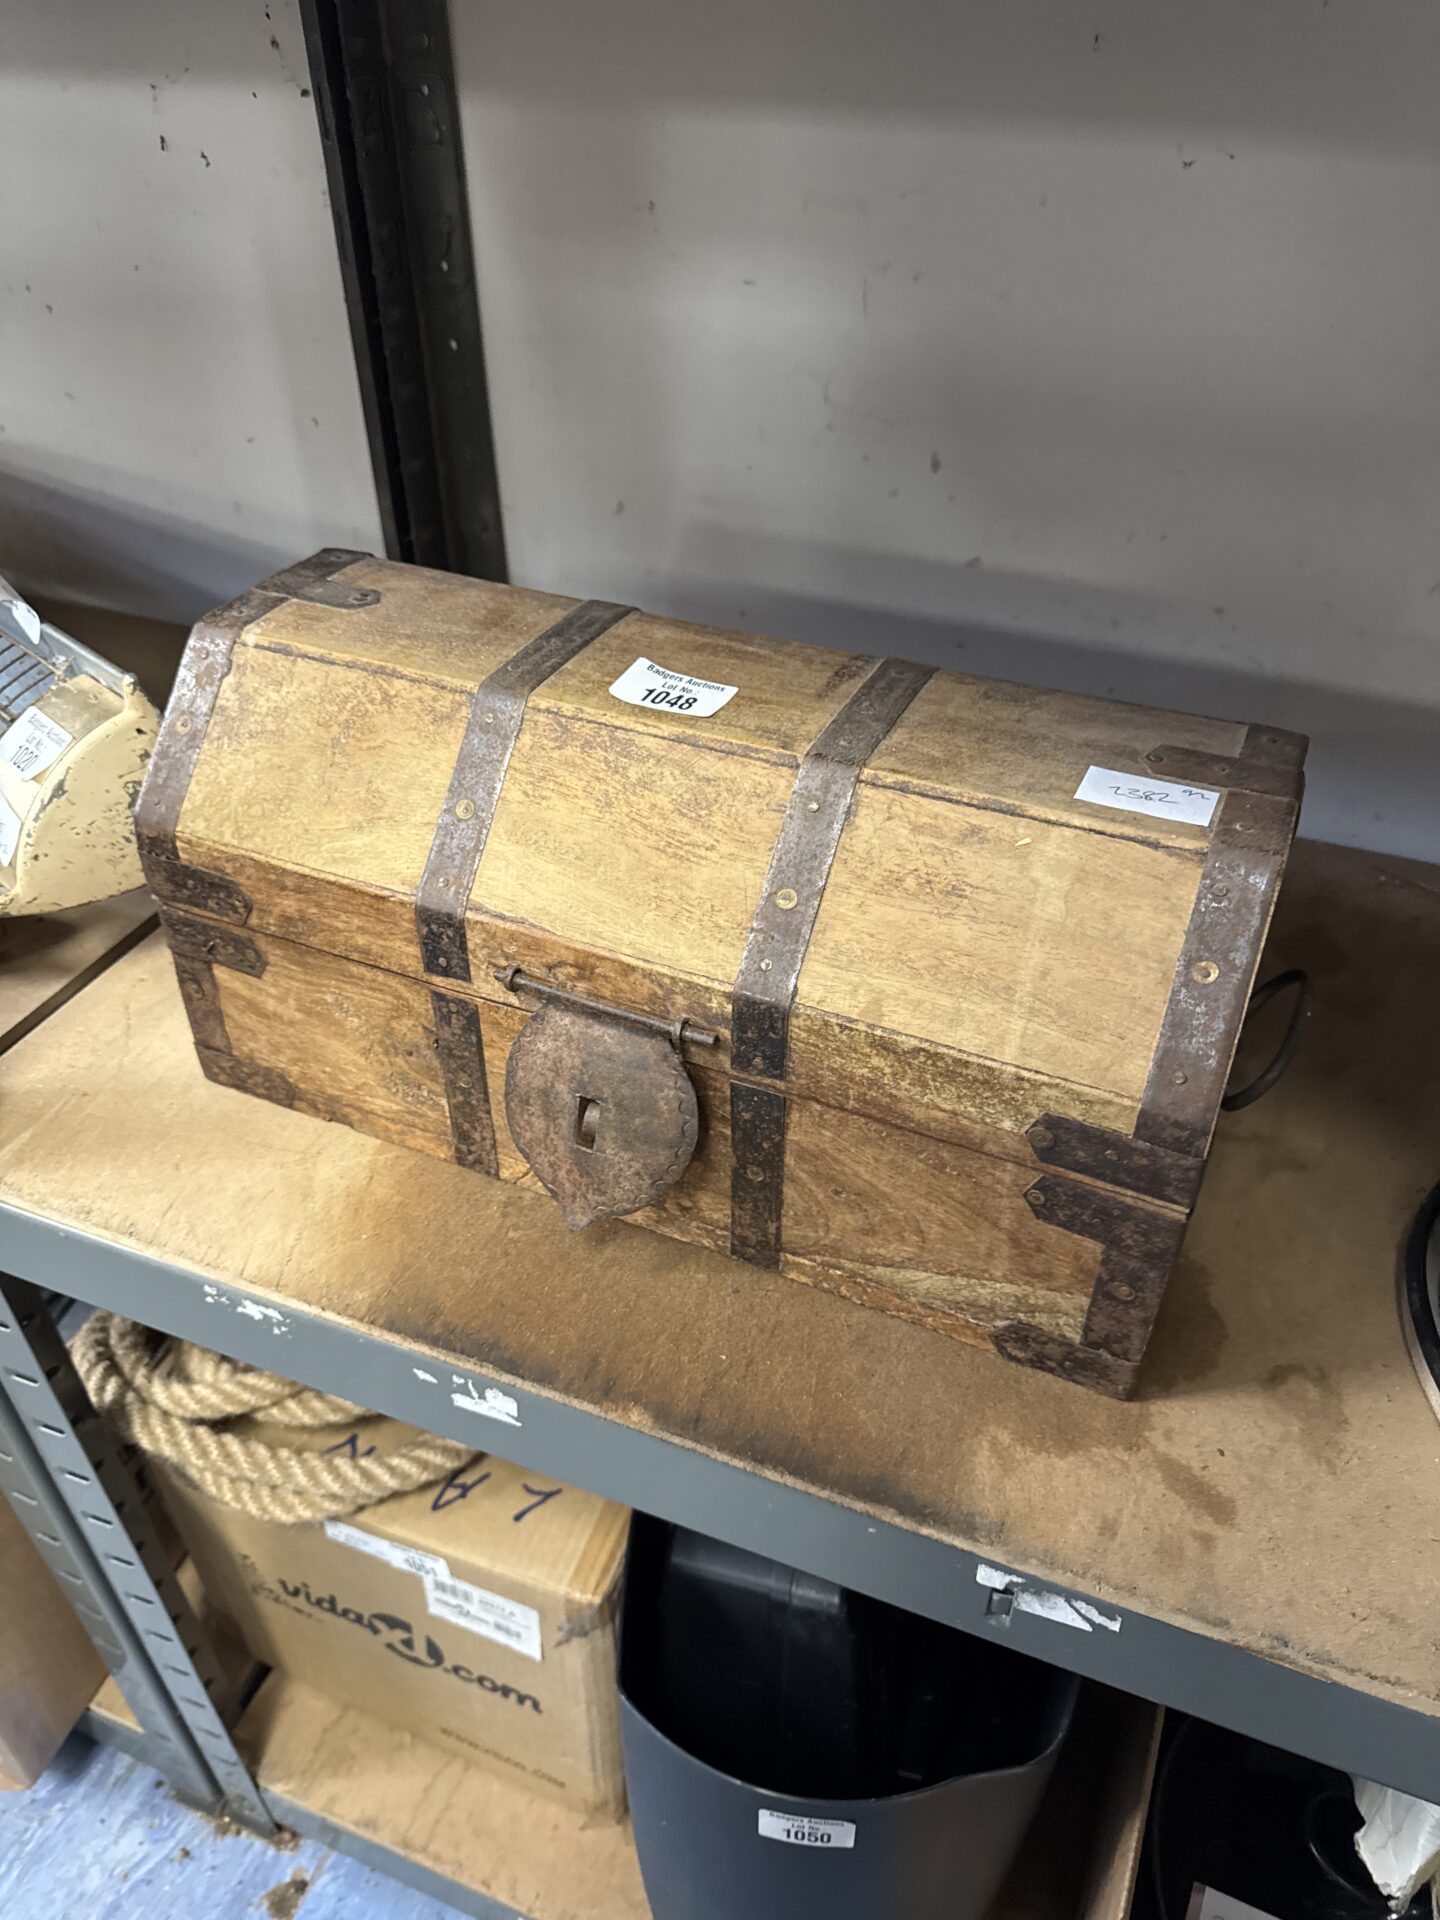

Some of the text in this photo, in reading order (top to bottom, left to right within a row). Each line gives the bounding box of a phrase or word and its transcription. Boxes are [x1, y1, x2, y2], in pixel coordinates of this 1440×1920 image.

[647, 664, 726, 693] Badgers Auctions
[661, 681, 678, 691] Lot
[641, 688, 698, 710] 1048
[9, 745, 40, 772] 1020
[782, 1828, 831, 1845] 1050
